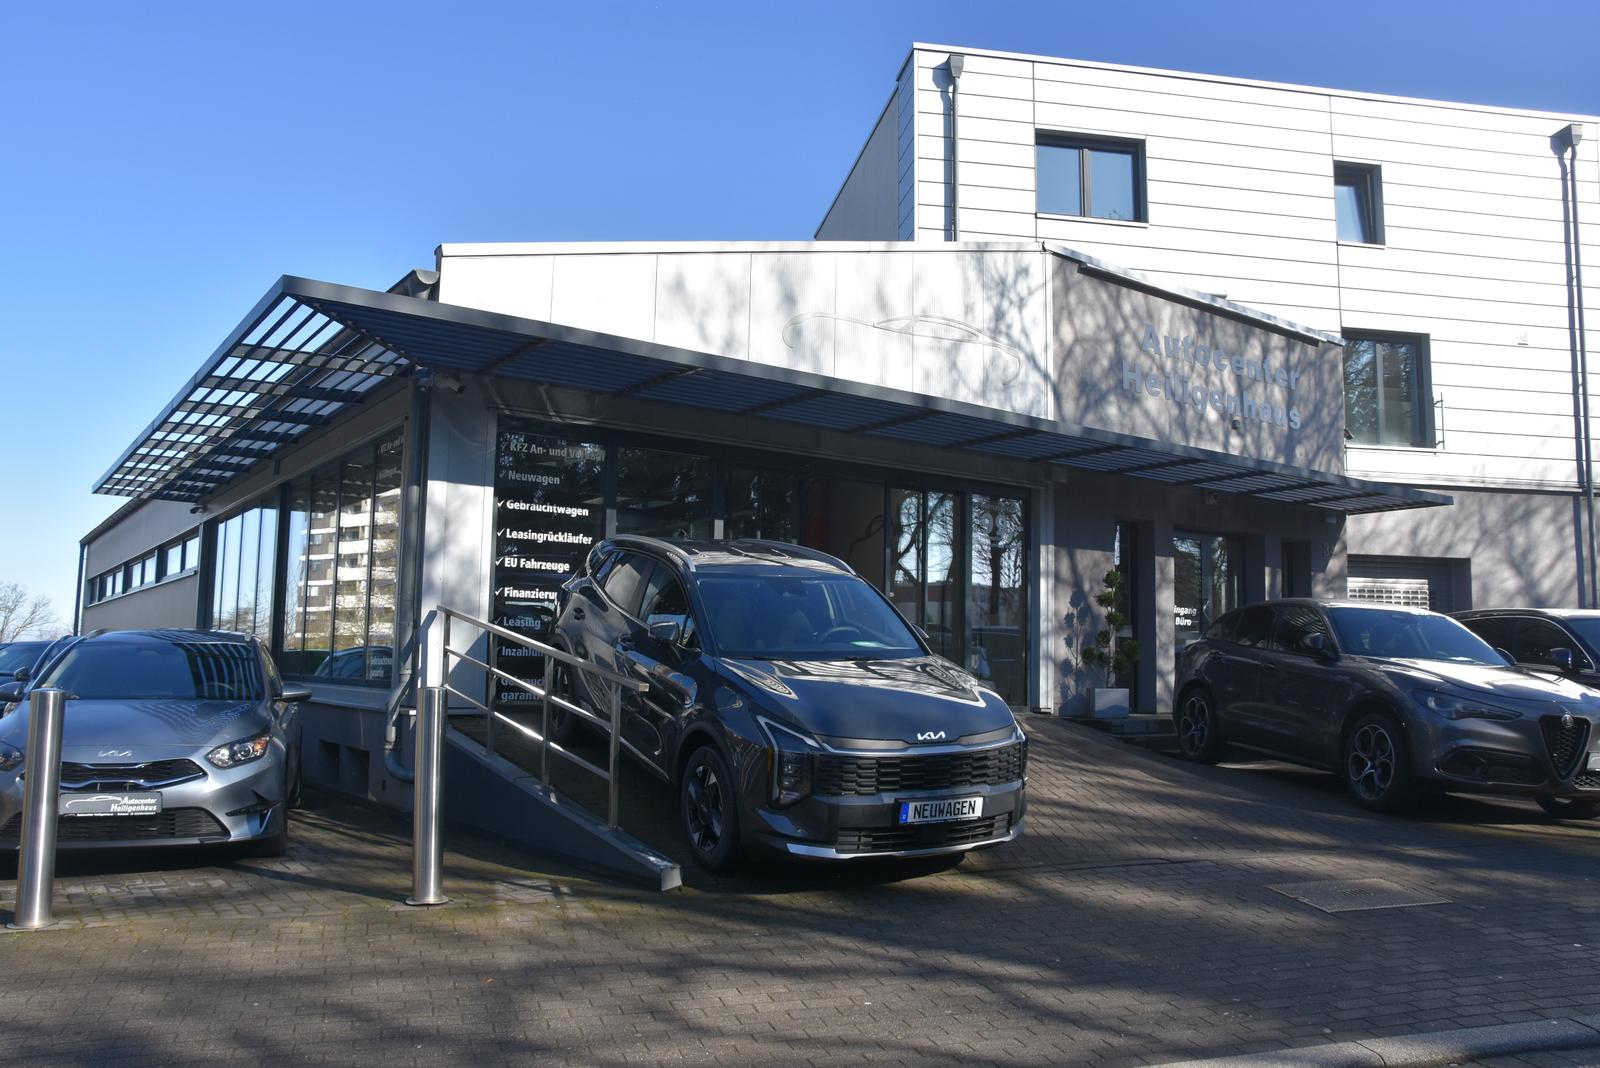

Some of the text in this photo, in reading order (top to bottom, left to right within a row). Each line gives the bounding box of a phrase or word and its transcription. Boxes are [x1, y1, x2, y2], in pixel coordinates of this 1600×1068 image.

[1142, 324, 1300, 391] Autocenter
[1121, 359, 1301, 430] Heiligenhaus
[510, 442, 528, 452] KFZ
[530, 444, 547, 455] An-
[549, 448, 567, 457] und
[508, 470, 560, 485] Neuwagen
[506, 500, 589, 517] Gebrauchtwagen
[506, 528, 593, 545] Leasingrückläufer
[504, 557, 570, 573] EU Fahrzeuge
[504, 587, 557, 600] Finanzieru
[1173, 605, 1197, 616] ingang
[503, 617, 541, 630] Leasing
[1175, 617, 1192, 626] Büro
[110, 803, 157, 812] Heiligenhaus
[122, 796, 157, 805] Autocenter
[913, 800, 976, 819] NEUWAGEN
